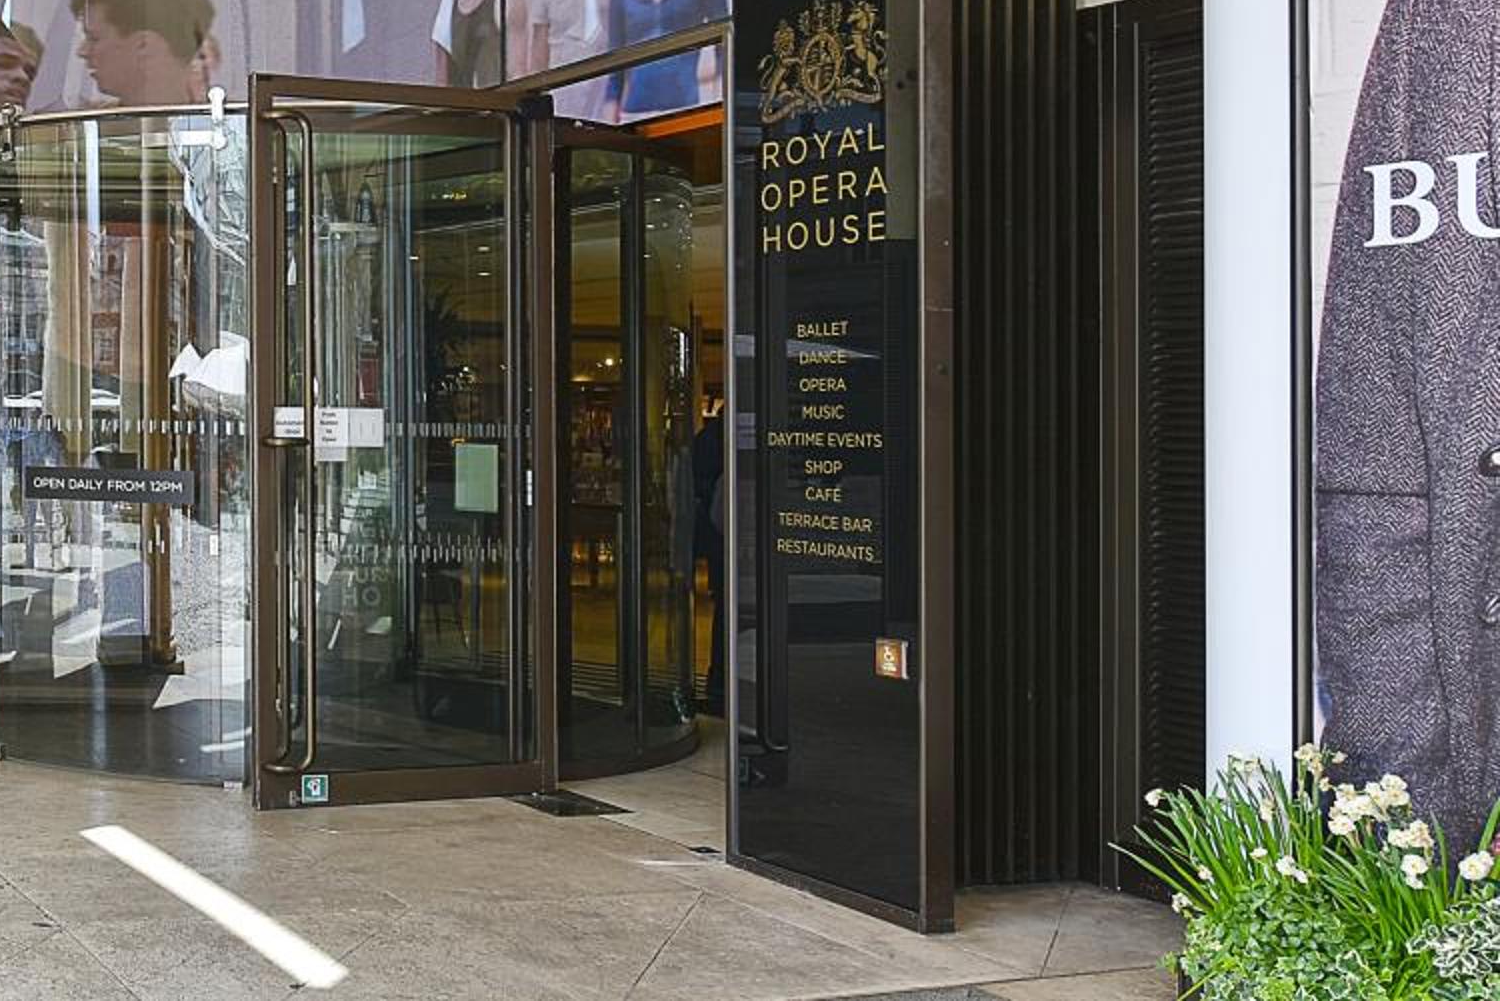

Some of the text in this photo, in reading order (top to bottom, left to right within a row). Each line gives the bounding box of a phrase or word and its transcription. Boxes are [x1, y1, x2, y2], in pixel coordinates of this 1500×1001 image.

[762, 122, 885, 170] ROYAL
[761, 166, 888, 212] OPERA
[762, 210, 886, 254] HOUSE
[796, 320, 849, 339] BALLET
[799, 350, 848, 365] DANCE
[799, 377, 847, 393] OPERA
[801, 404, 846, 420] MUSIC
[768, 432, 884, 449] DAYTIME EVENTS
[804, 459, 844, 475] SHOP
[32, 476, 184, 494] OPEN DAILY FROM 12PM
[804, 486, 843, 503] CAFE
[777, 511, 873, 532] TERRACE BAR
[776, 537, 876, 563] RESTAURANTS
